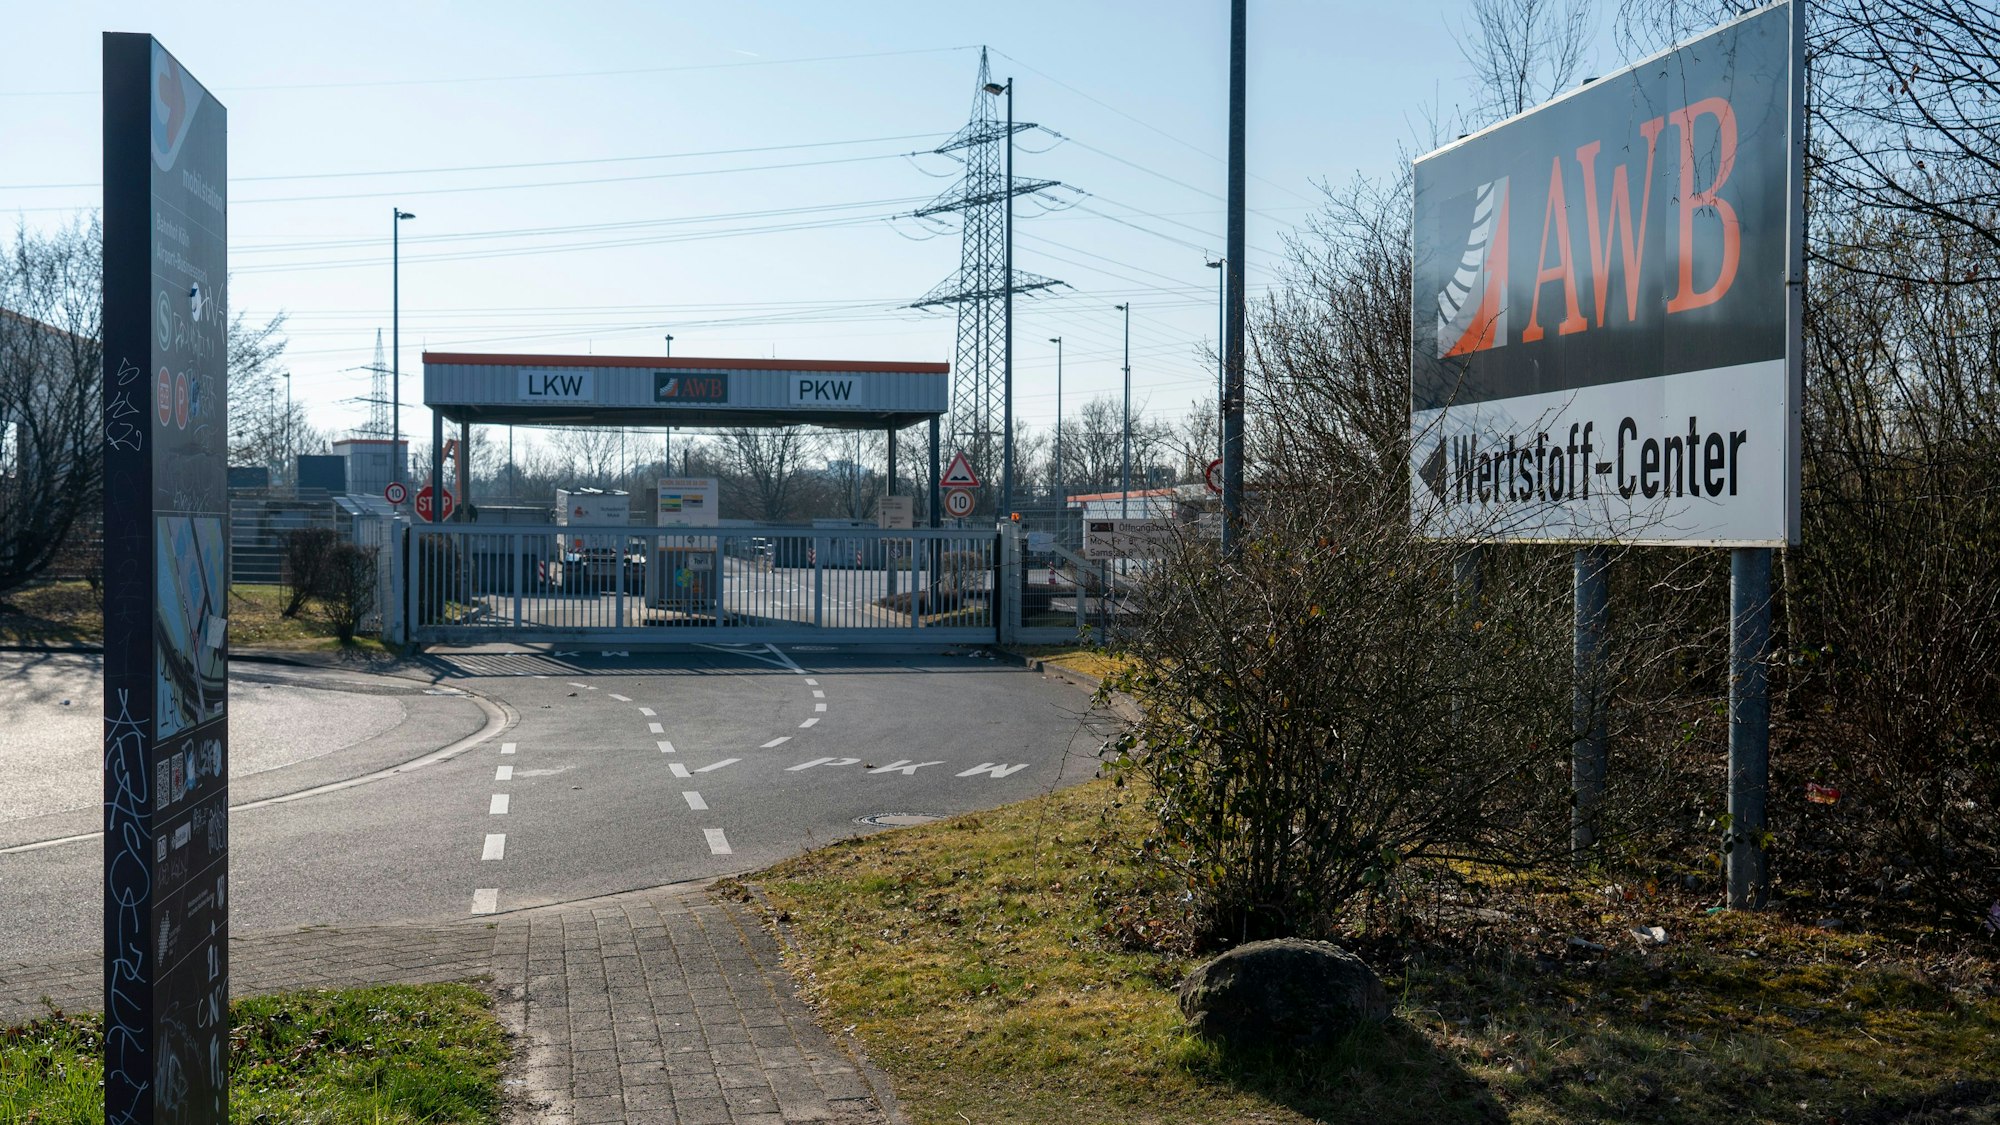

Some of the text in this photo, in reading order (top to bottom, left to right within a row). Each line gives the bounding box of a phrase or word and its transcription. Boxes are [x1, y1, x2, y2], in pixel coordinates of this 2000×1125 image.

[1521, 96, 1741, 344] AWB
[528, 374, 583, 396] LKW
[681, 378, 723, 398] AWB
[800, 379, 853, 400] PKW
[1453, 416, 1747, 505] Wertstoff-Center
[391, 488, 401, 498] 10
[418, 496, 451, 511] STP
[953, 496, 967, 509] 10
[784, 757, 1031, 778] PKW
